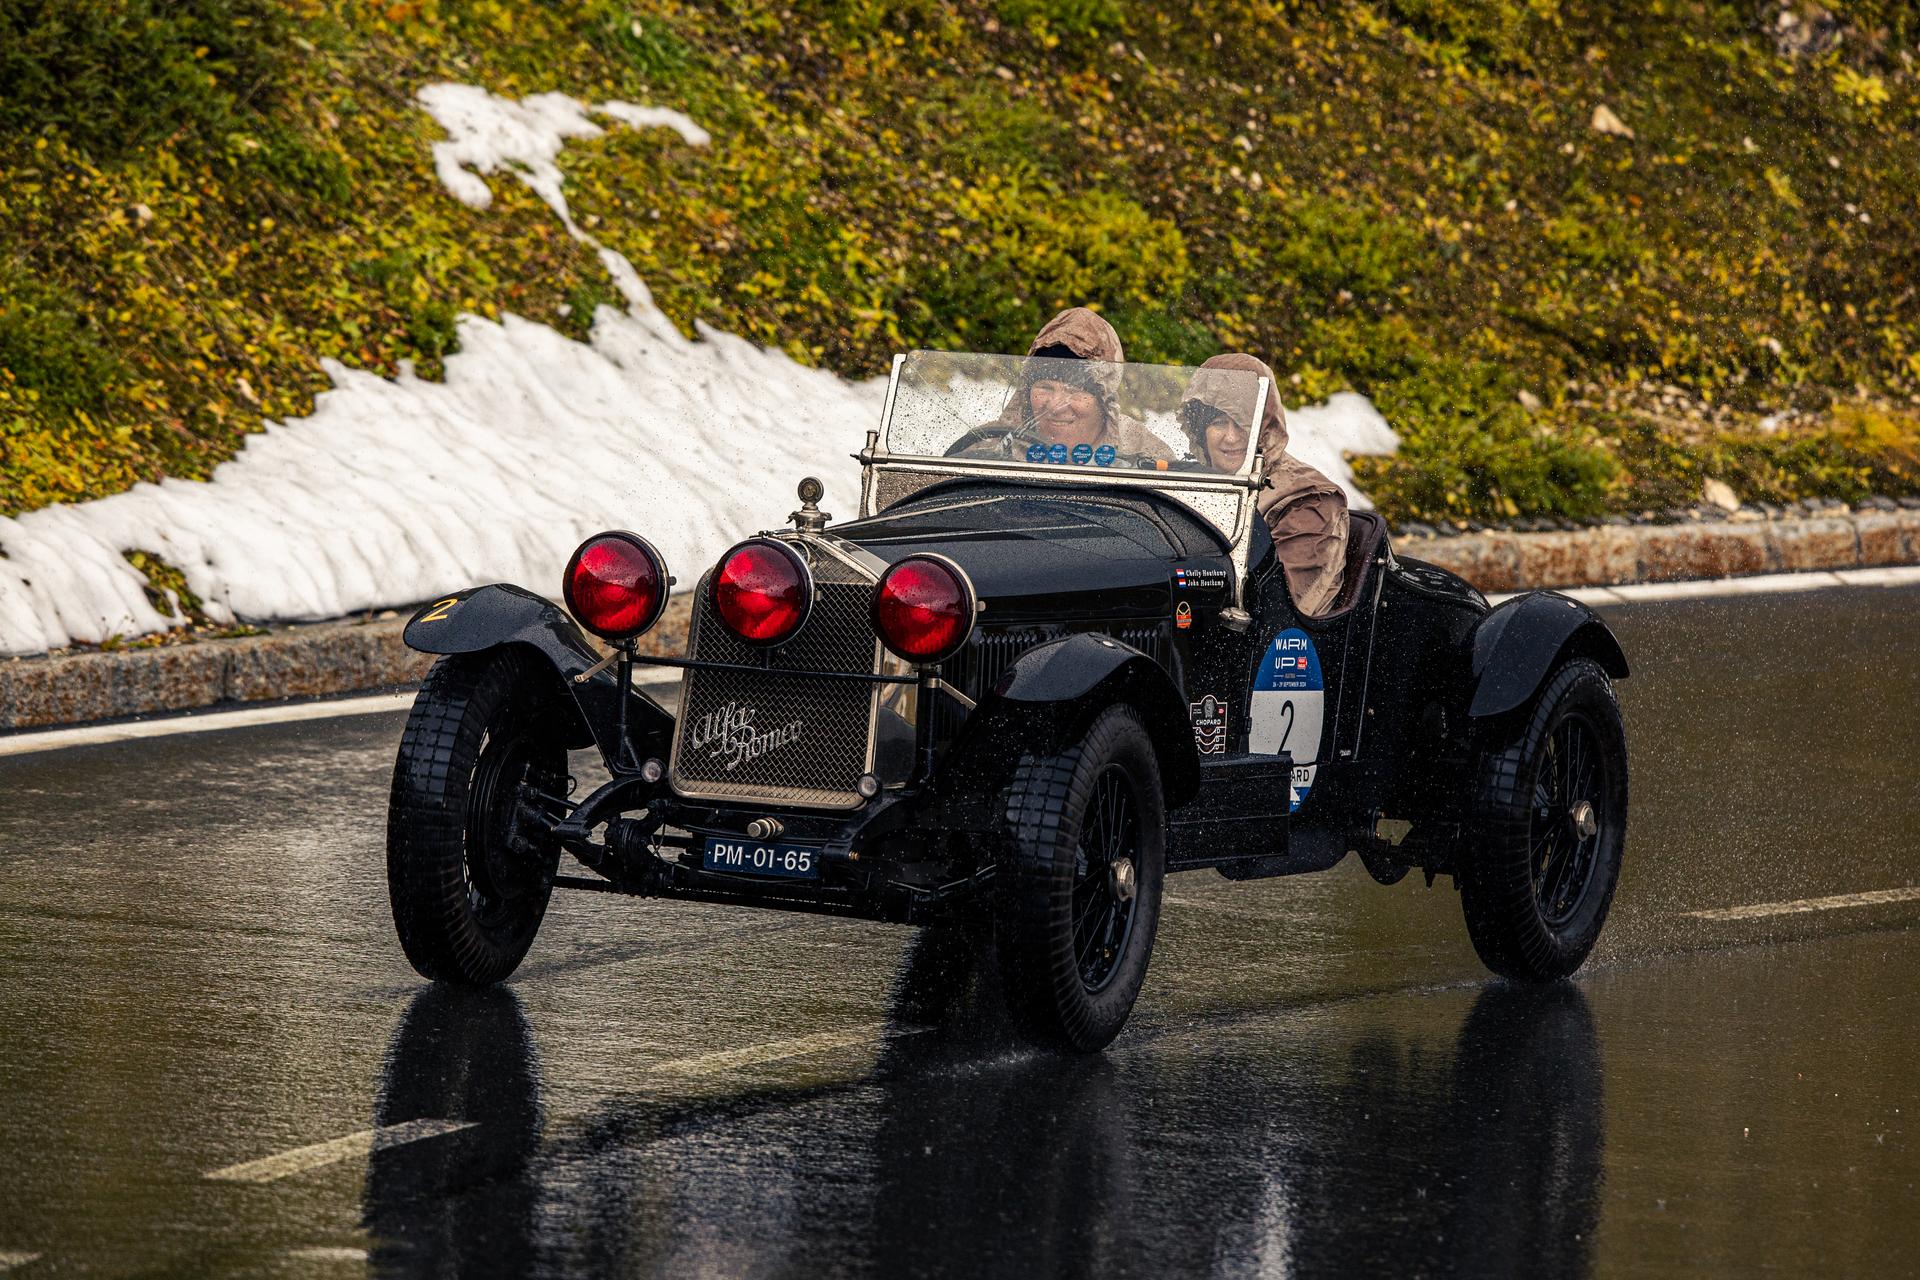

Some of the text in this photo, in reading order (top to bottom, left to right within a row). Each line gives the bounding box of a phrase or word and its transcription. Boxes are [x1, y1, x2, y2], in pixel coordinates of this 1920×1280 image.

[420, 598, 458, 623] 2
[1275, 638, 1308, 651] WARM
[1274, 657, 1296, 670] UP
[692, 701, 755, 758] Alfa
[1277, 700, 1294, 755] 2
[723, 719, 803, 771] Romeo
[713, 843, 812, 873] PM-01-65
